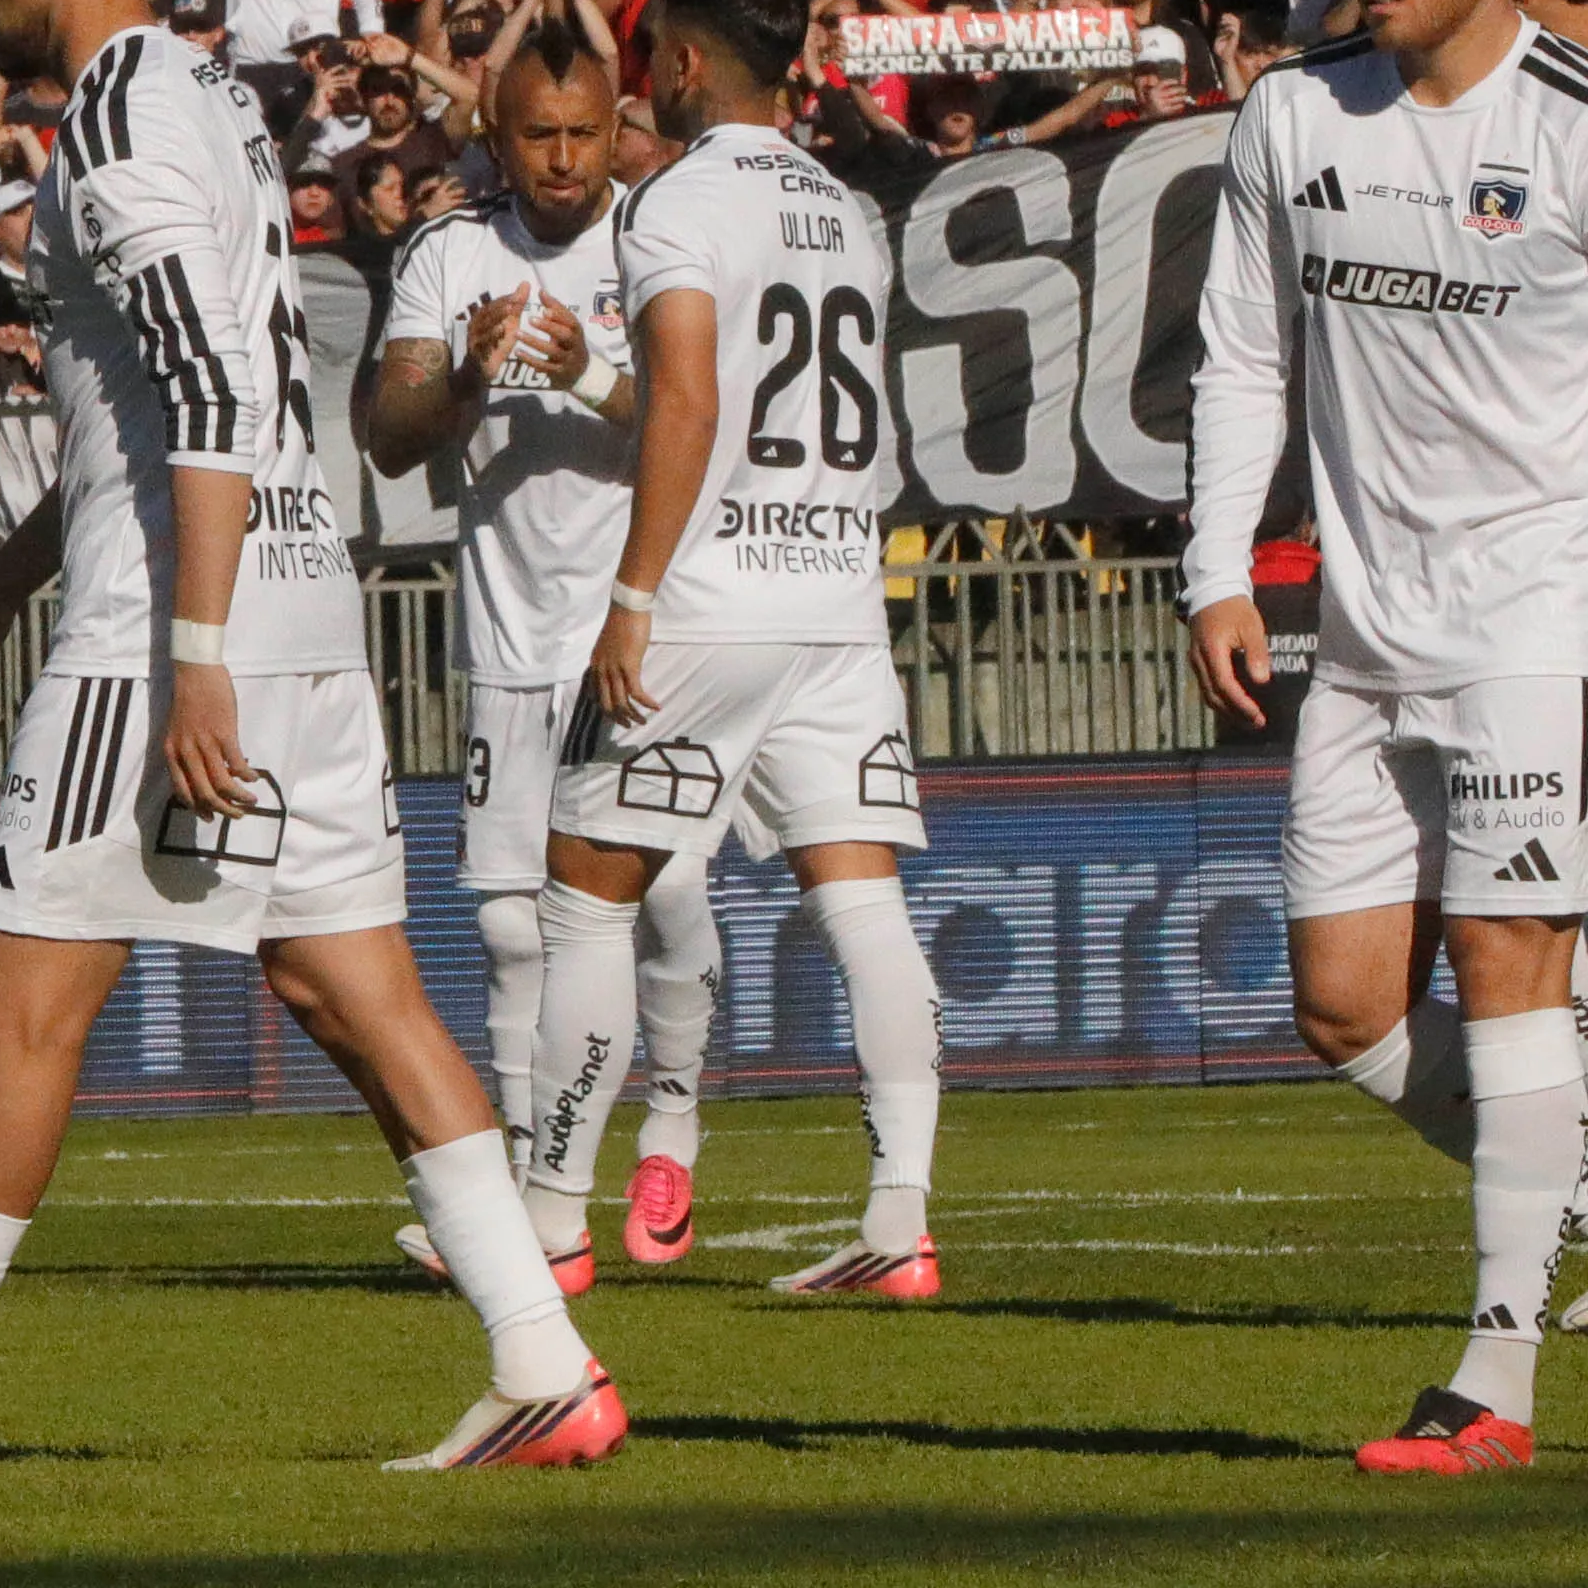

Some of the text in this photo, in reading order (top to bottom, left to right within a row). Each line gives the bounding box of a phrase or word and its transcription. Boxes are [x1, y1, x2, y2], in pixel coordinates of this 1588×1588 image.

[841, 9, 1134, 55] SANTA MARA
[951, 52, 986, 73] TE
[991, 49, 1135, 72] FALLAMOS
[780, 172, 842, 202] CARD
[1354, 183, 1454, 210] JETOUR
[781, 210, 845, 255] ULLOA
[746, 280, 879, 473] 26
[714, 497, 874, 543] DIRECTV
[1451, 769, 1565, 801] PHILIPS
[1493, 804, 1566, 833] Audio
[547, 1030, 613, 1174] AutoPlanet
